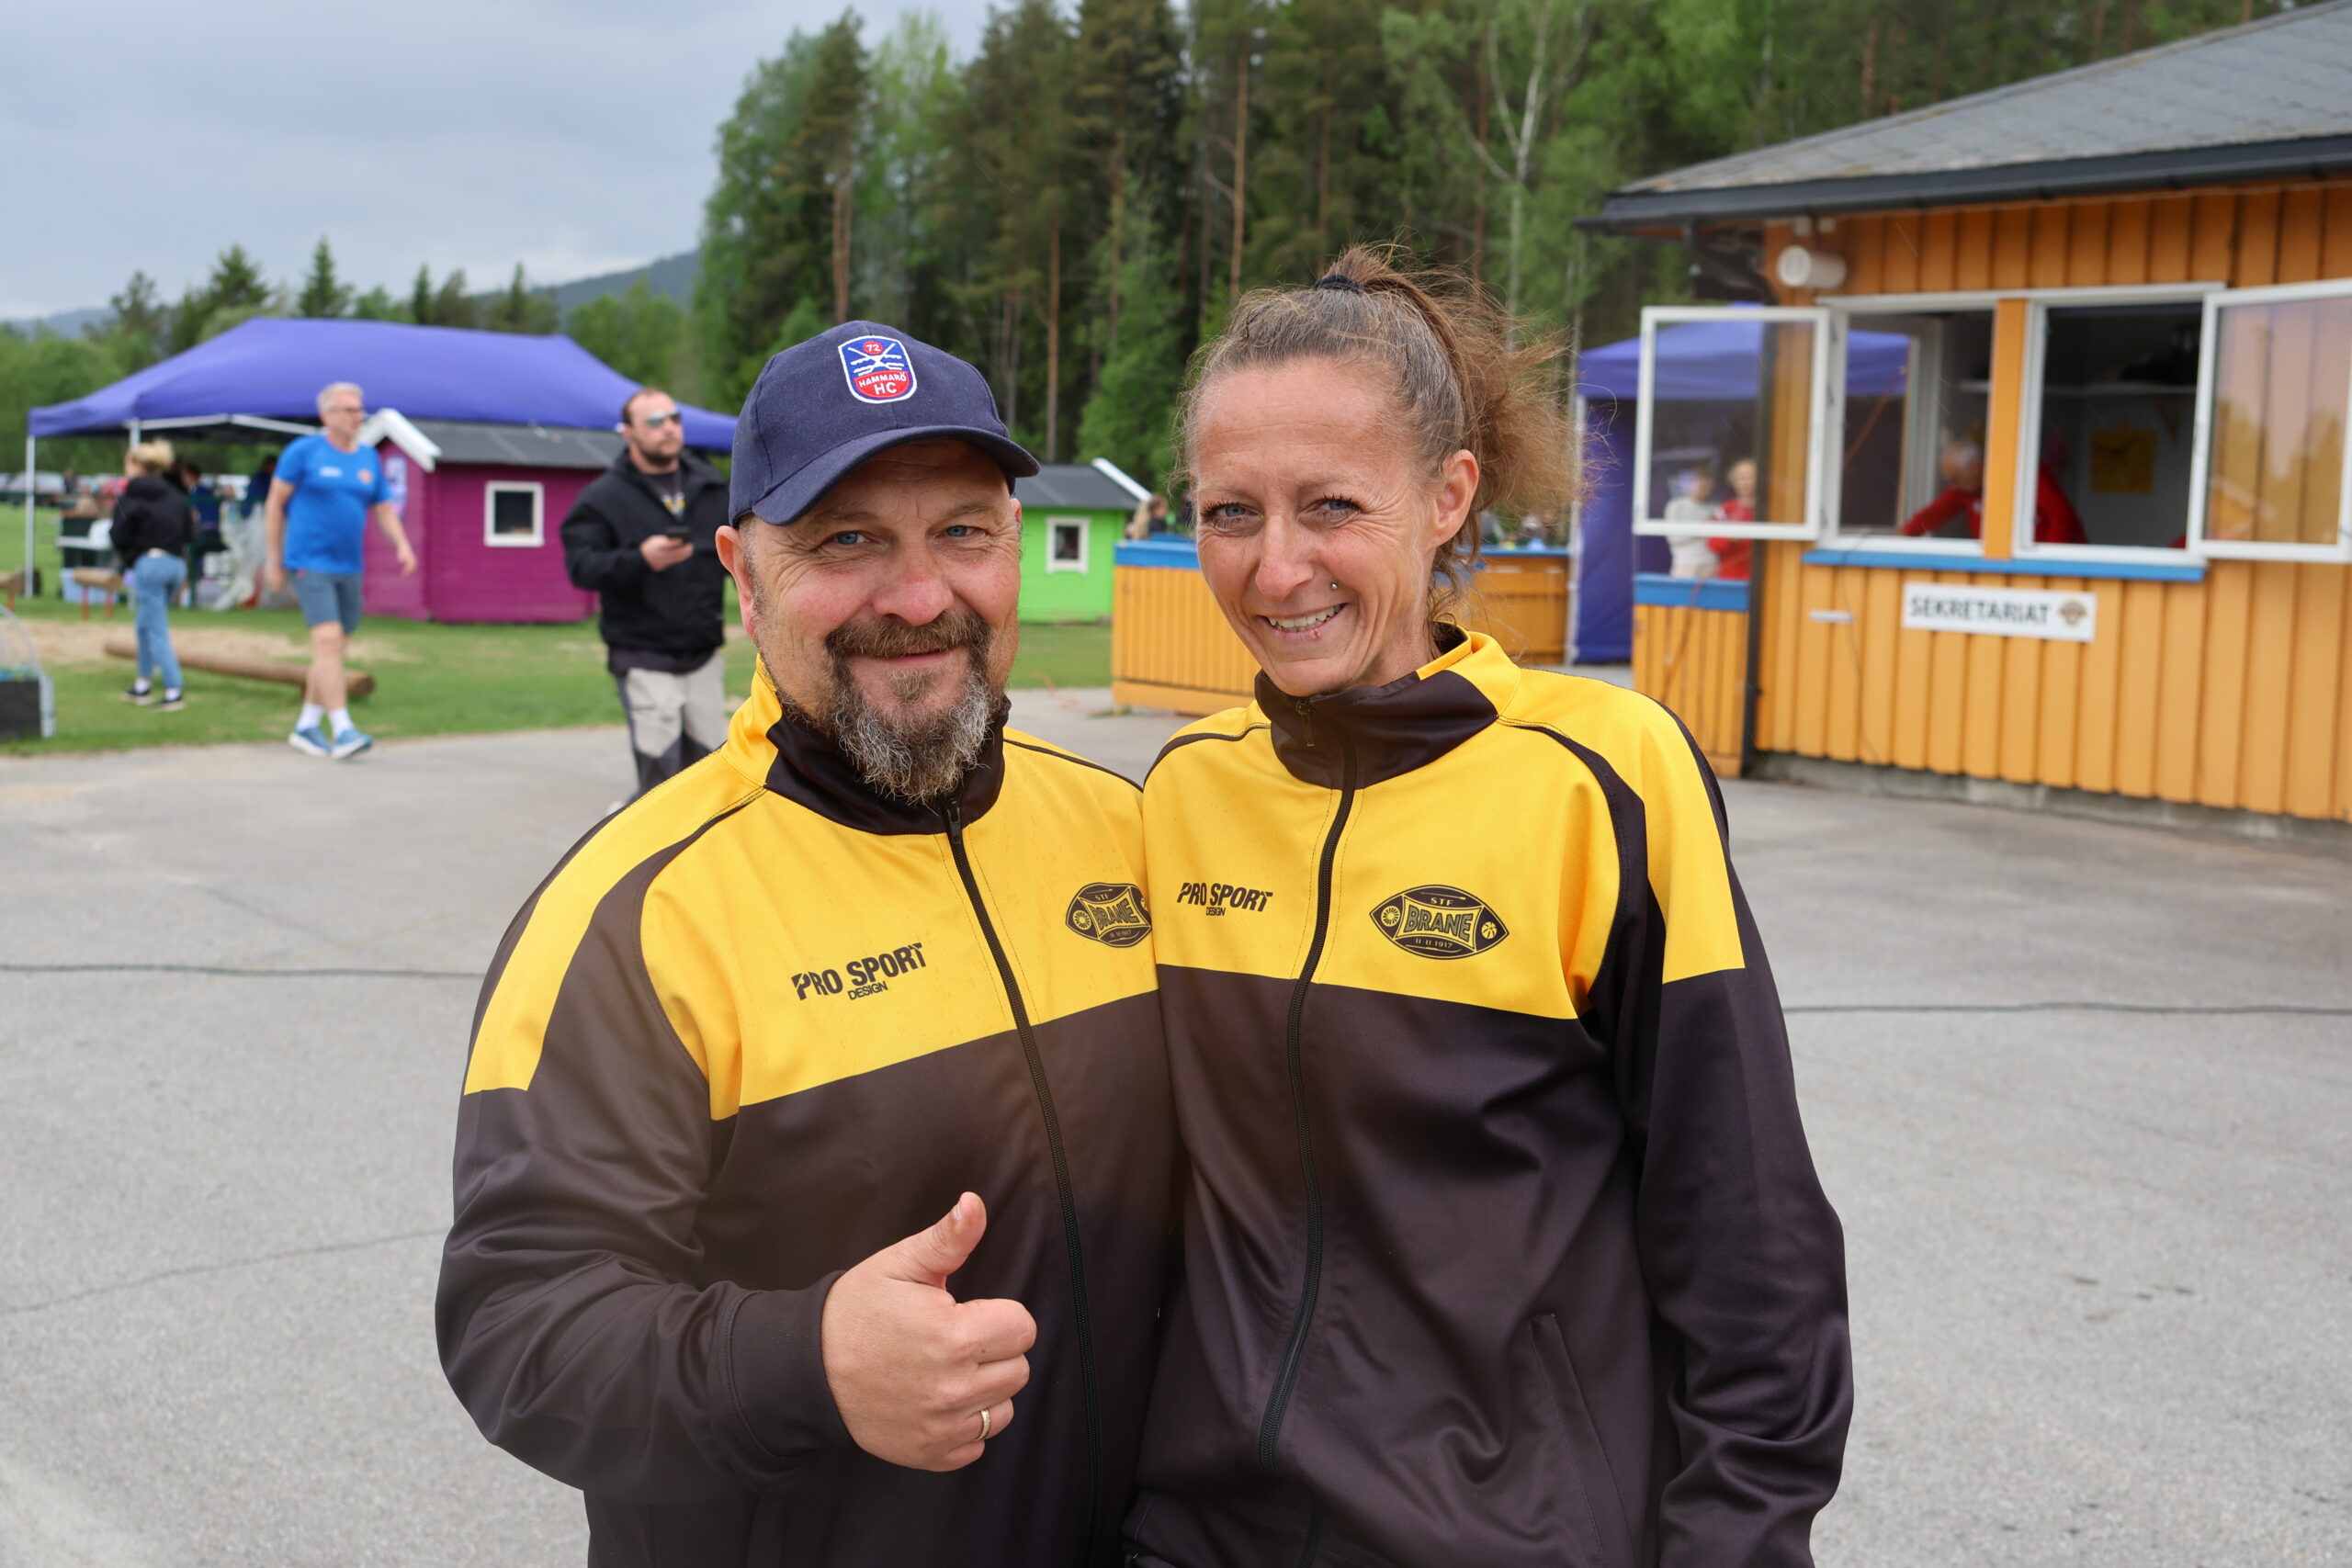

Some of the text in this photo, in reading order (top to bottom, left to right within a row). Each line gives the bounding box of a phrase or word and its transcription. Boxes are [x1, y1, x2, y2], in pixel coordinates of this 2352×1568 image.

[865, 344, 880, 352] 72
[858, 372, 907, 388] HAMMARÖ
[874, 382, 897, 395] HC
[1910, 597, 2049, 625] SEKRETARIAT
[1176, 882, 1273, 912] PRO SPORT
[1430, 897, 1453, 907] STF
[1205, 907, 1226, 916] DESIGN
[1403, 904, 1474, 942] BRANE
[790, 942, 927, 1001] PRO SPORT
[847, 981, 888, 1000] DESIGN
